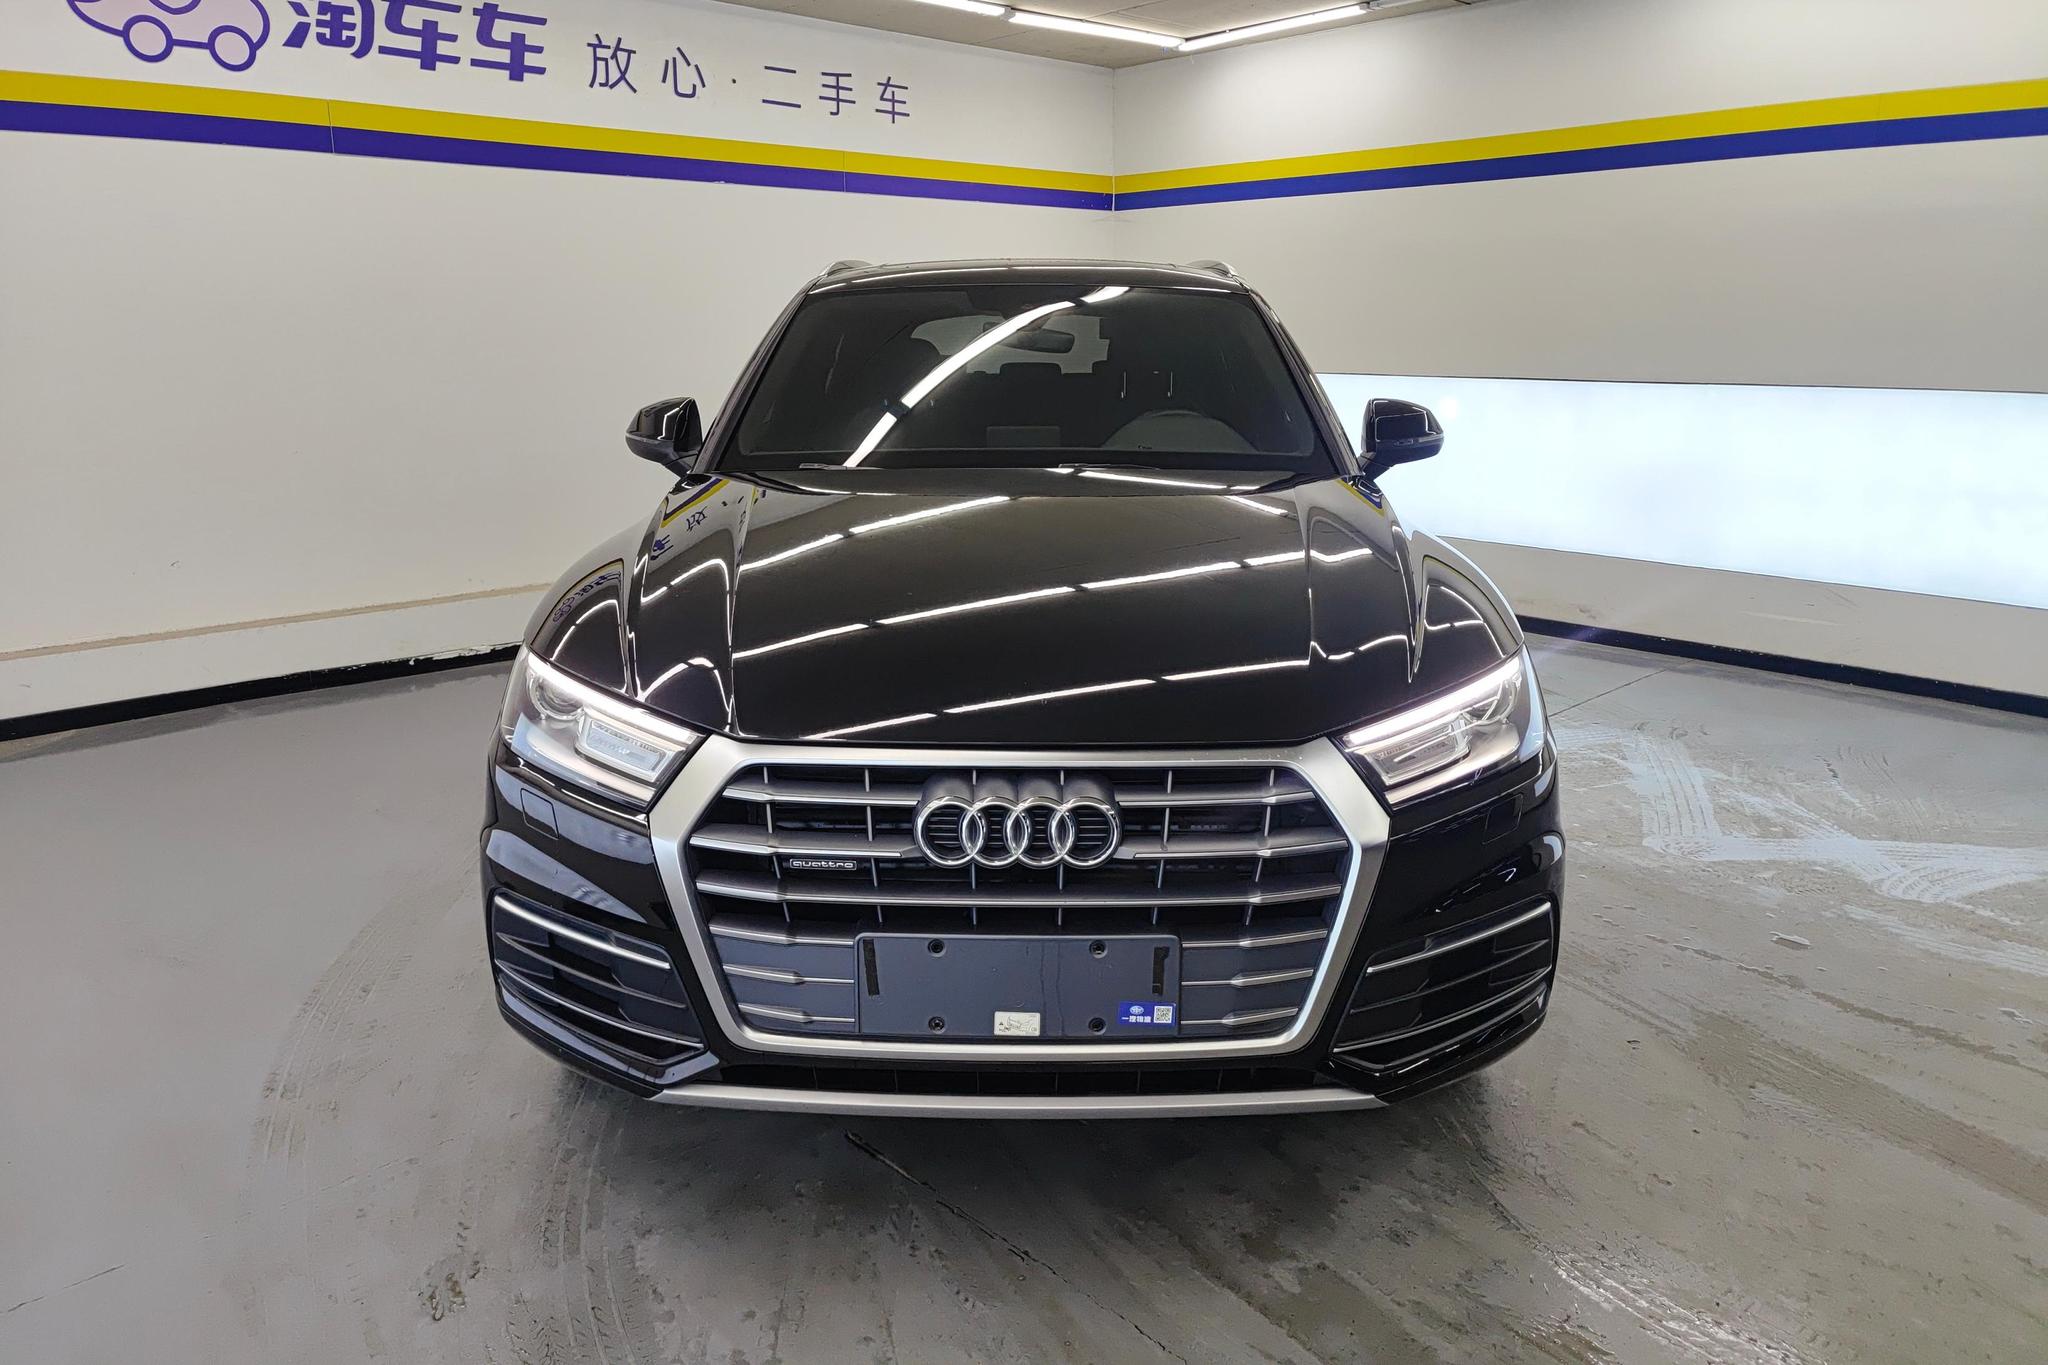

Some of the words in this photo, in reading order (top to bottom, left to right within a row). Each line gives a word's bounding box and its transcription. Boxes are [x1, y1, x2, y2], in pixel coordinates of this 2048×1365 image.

[281, 0, 548, 82] 淘车车
[792, 860, 854, 869] quattro
